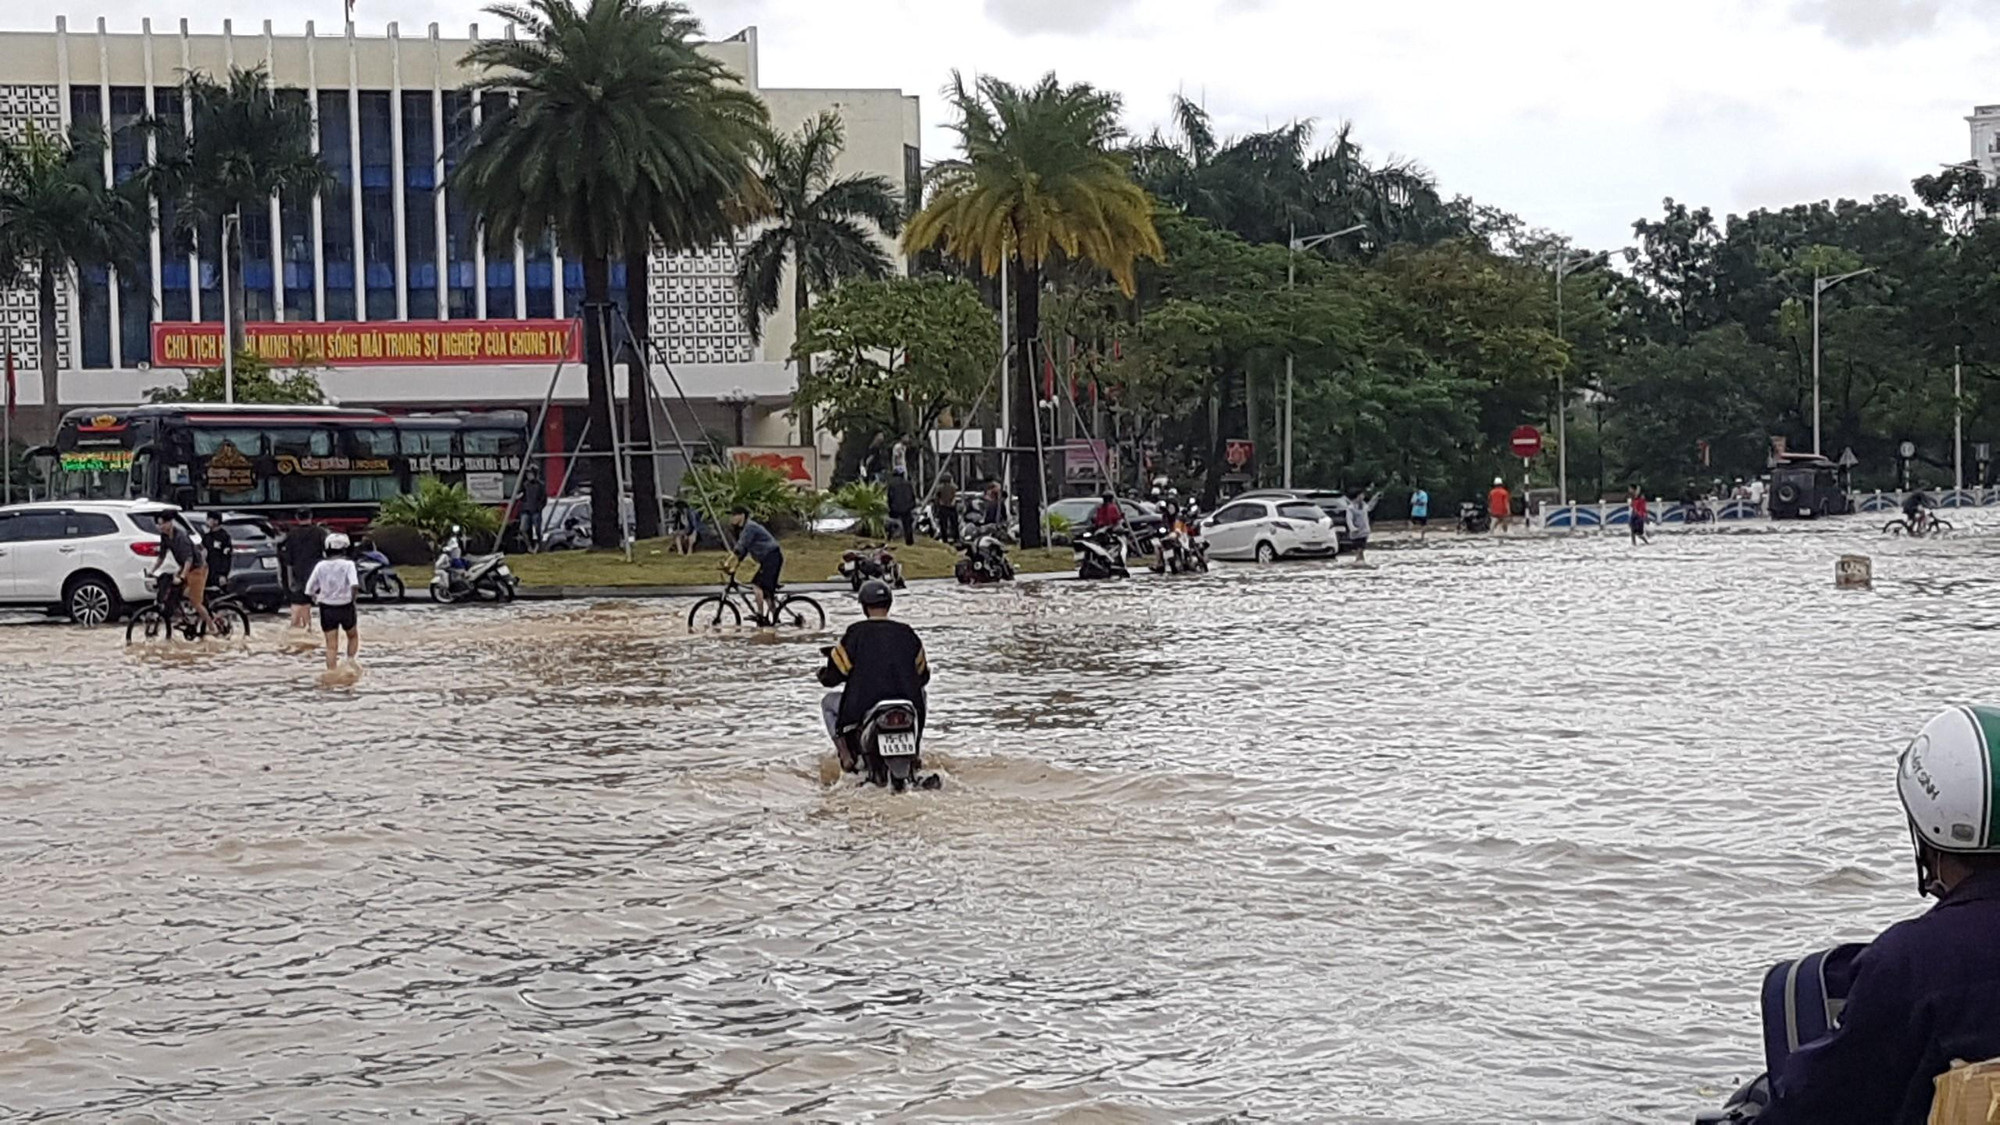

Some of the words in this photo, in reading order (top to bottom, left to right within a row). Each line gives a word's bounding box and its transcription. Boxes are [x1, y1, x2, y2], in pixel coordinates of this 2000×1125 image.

[164, 329, 188, 359] CHỦ
[190, 334, 216, 363] TỊCH
[259, 334, 290, 358] MINH
[327, 327, 358, 358] SỐNG
[360, 329, 383, 357] MÃI
[384, 333, 421, 358] TRONG
[442, 328, 482, 360] NGHIỆP
[484, 326, 508, 356] CỦA
[509, 327, 546, 357] CHÚNG
[548, 331, 562, 356] TA
